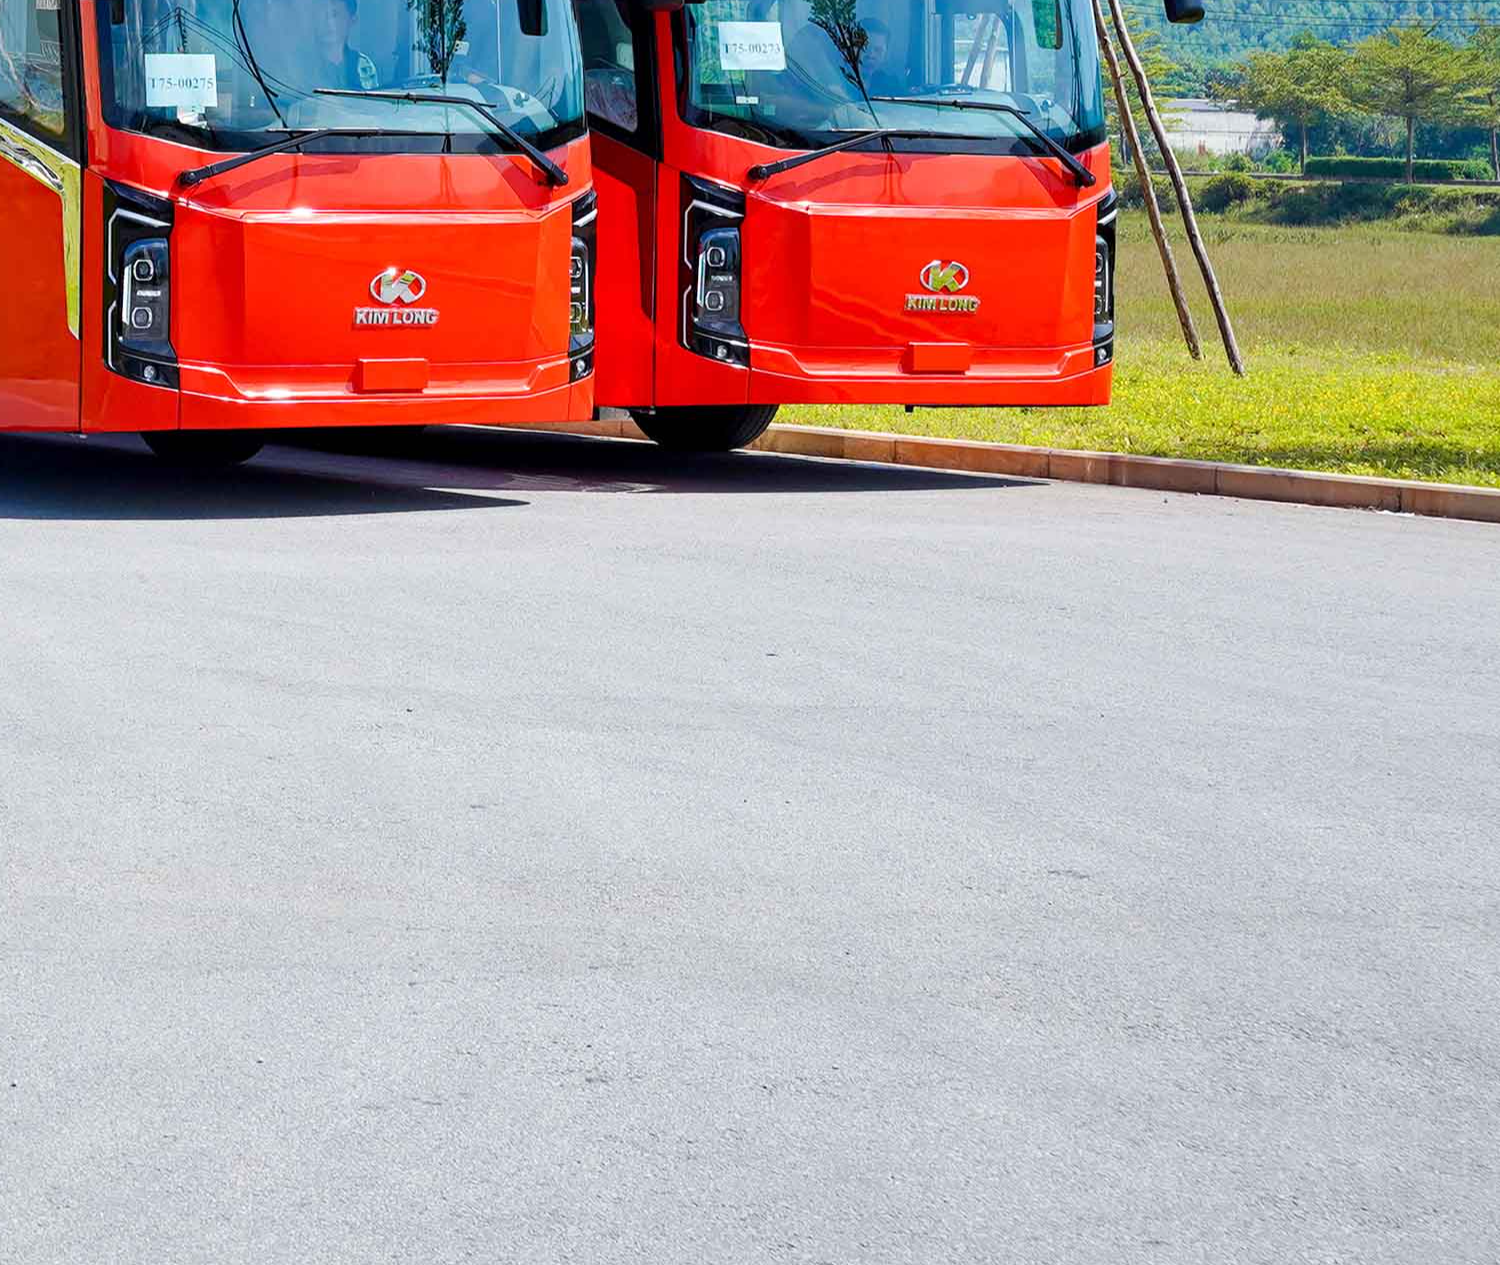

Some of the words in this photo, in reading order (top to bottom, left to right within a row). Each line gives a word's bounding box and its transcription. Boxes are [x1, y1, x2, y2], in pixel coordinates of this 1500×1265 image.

[148, 76, 215, 91] T75-00275
[904, 294, 937, 311] KIM
[938, 294, 981, 313] LONG
[353, 307, 391, 326] KIM
[391, 307, 440, 326] LONG
